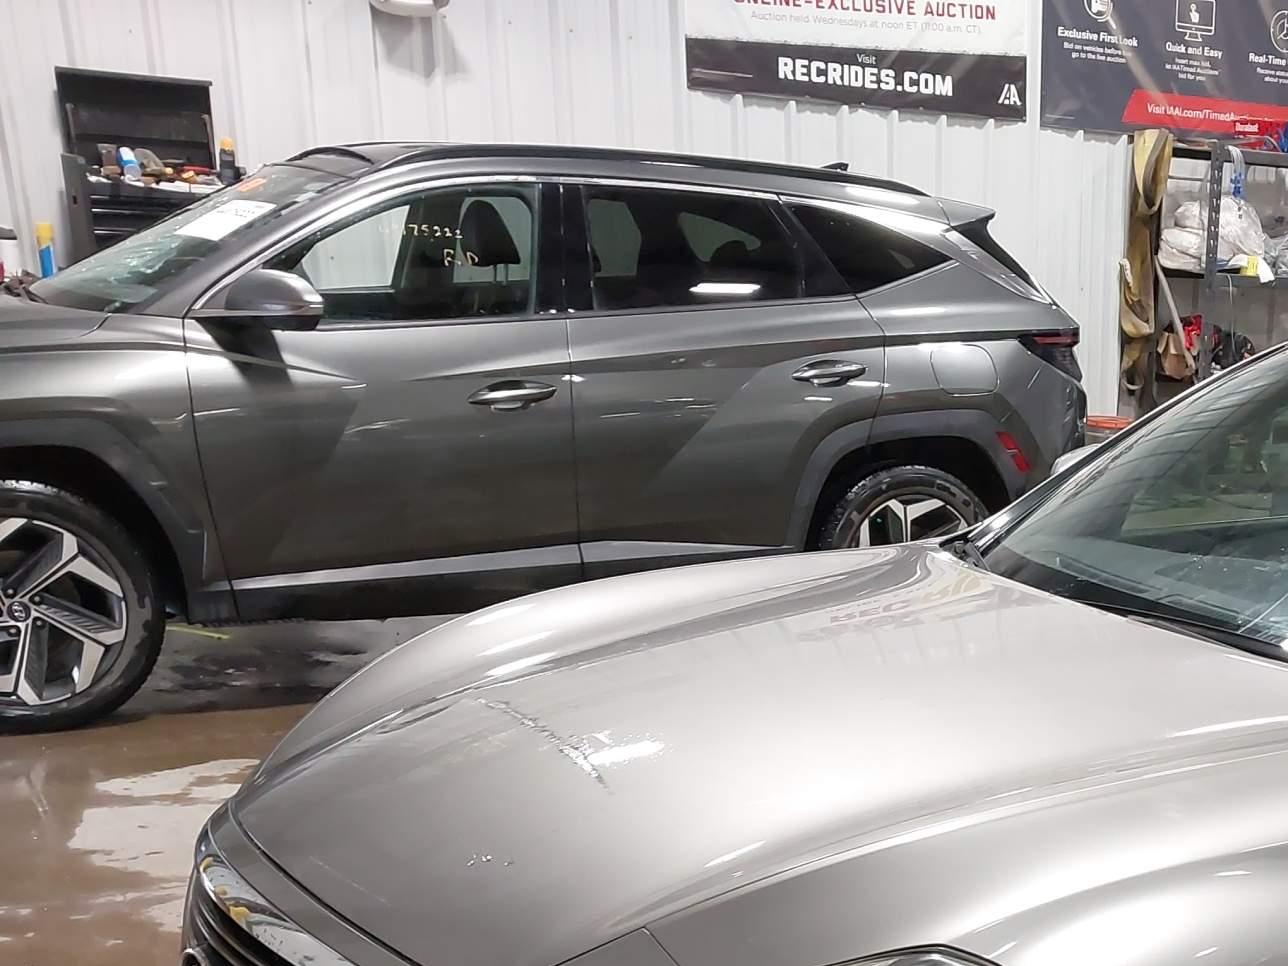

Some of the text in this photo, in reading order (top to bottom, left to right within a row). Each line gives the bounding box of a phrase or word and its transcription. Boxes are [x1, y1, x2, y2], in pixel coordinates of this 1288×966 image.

[734, 0, 996, 20] -EXCLUSIVE AUCTION
[752, 11, 788, 22] Auction
[790, 14, 810, 24] held
[813, 15, 868, 28] Wednesdays
[881, 21, 904, 30] noon
[906, 21, 919, 30] ET
[1057, 26, 1138, 47] Exclusive First Look
[856, 54, 877, 65] Visit
[1166, 42, 1223, 59] Quick and Easy
[1248, 53, 1287, 66] Real-Time
[777, 56, 953, 97] RECRIDES.COM
[1147, 102, 1165, 113] Visit
